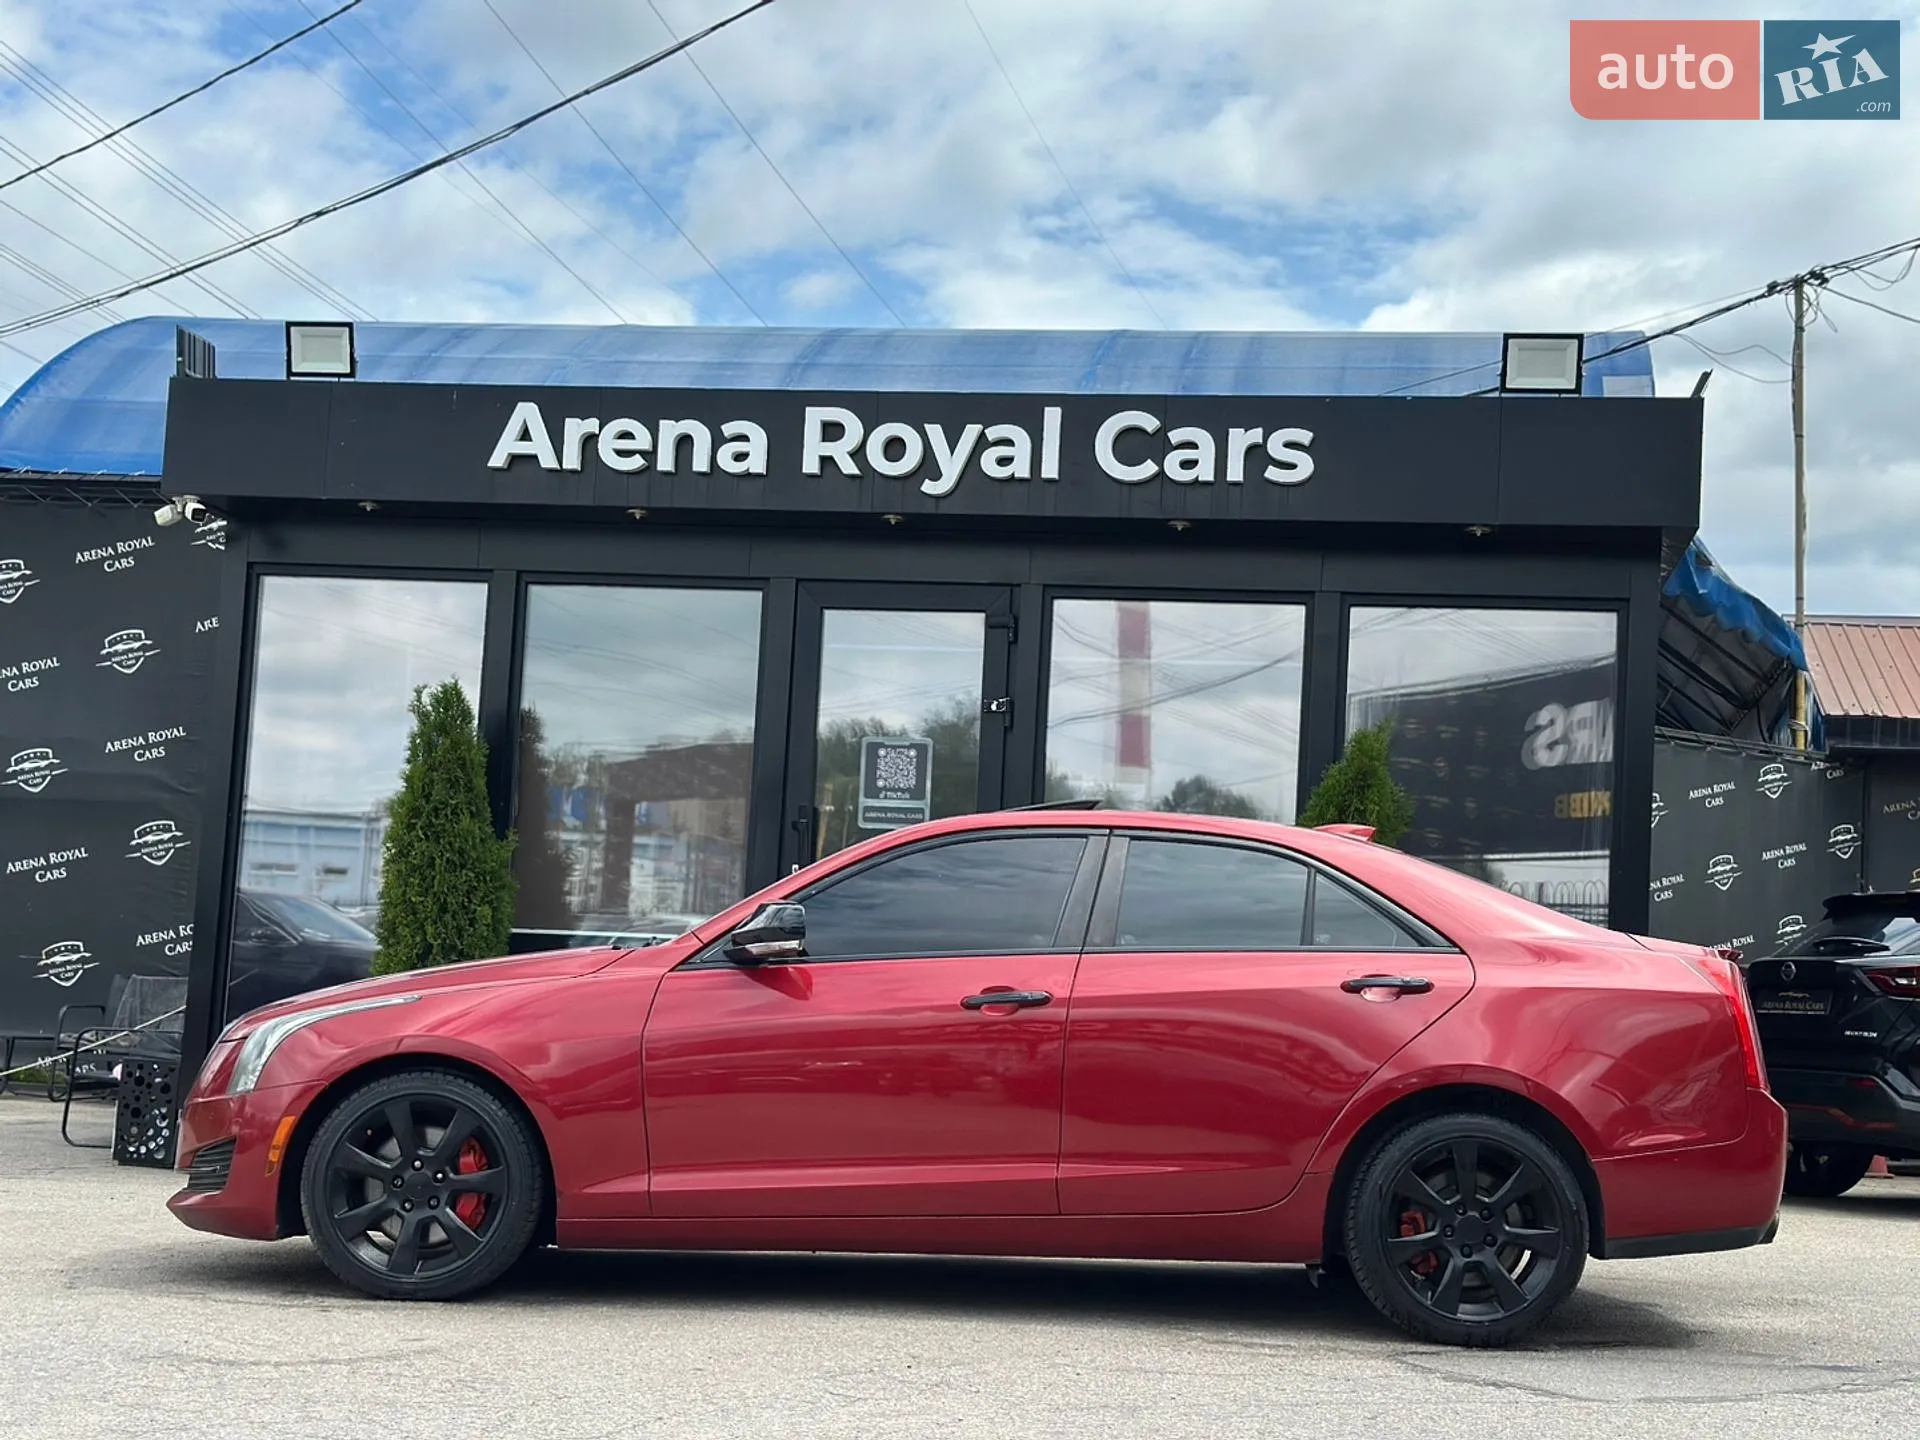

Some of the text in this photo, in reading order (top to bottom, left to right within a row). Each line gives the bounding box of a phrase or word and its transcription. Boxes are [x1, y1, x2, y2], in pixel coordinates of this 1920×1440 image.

[487, 401, 1315, 496] Arena Royal Cars
[75, 536, 155, 564] ARENA ROYAL
[104, 556, 135, 572] CARS
[22, 656, 60, 673] ROYAL
[8, 676, 39, 691] CARS
[105, 726, 187, 754] ARENA ROYAL
[134, 747, 166, 762] CARS
[1688, 781, 1736, 800] ARENA ROYAL
[1705, 797, 1724, 808] CARS
[1882, 800, 1917, 814] ARENA
[6, 847, 88, 874] ARENA ROYAL
[35, 867, 67, 884] CARS
[136, 929, 176, 947] ARENA
[164, 940, 193, 956] CAR
